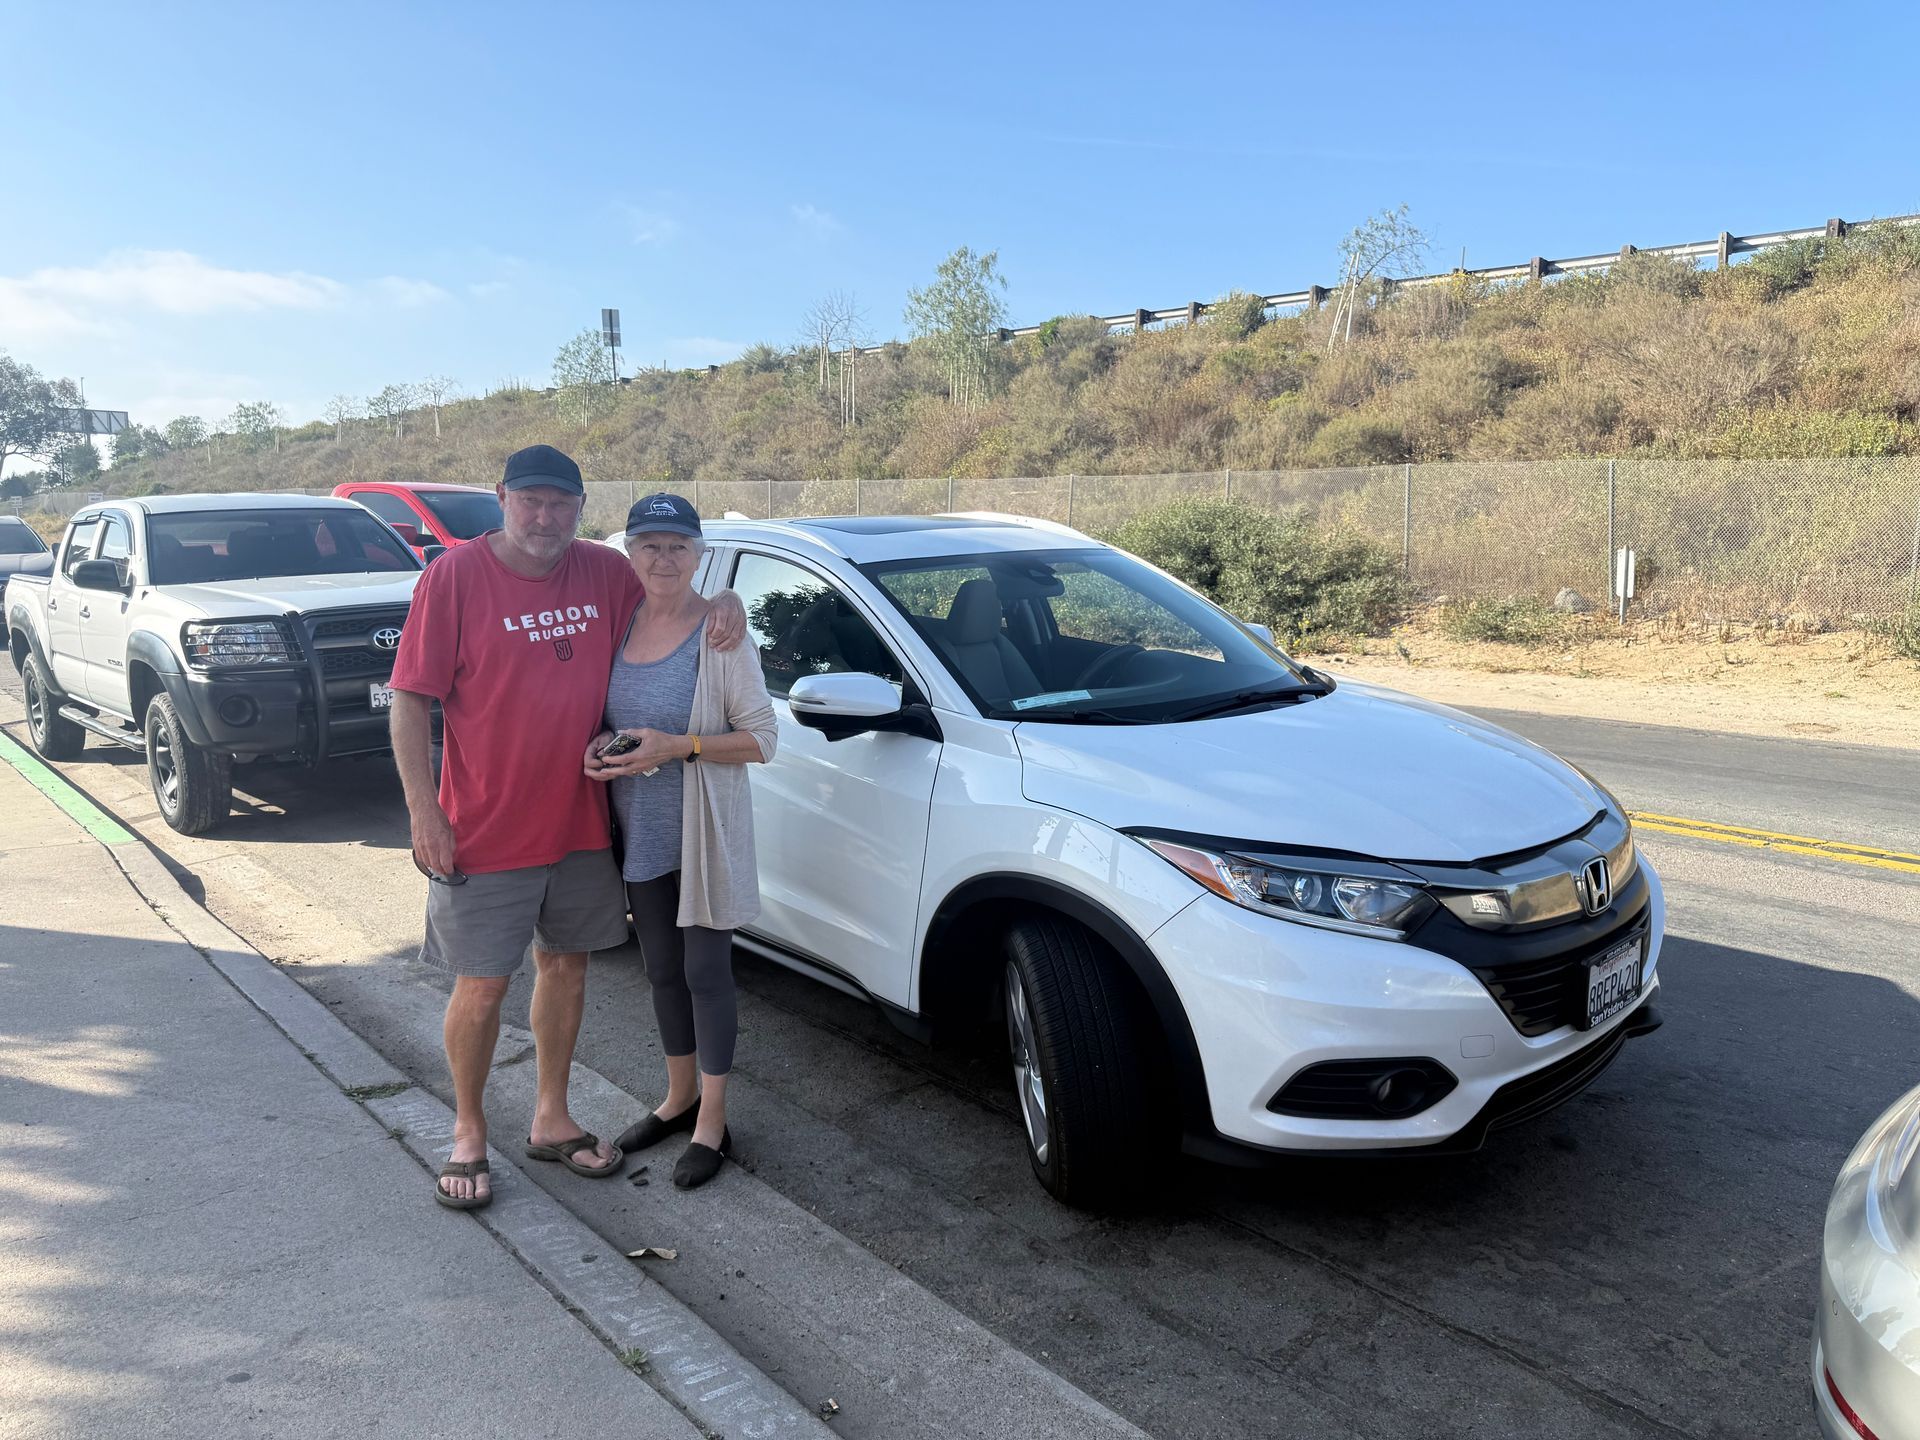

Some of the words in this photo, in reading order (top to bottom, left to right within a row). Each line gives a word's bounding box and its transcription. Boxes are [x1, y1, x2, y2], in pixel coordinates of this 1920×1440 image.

[503, 604, 599, 632] LEGION
[528, 622, 588, 642] RUGBY
[1589, 960, 1639, 1015] 8REP420
